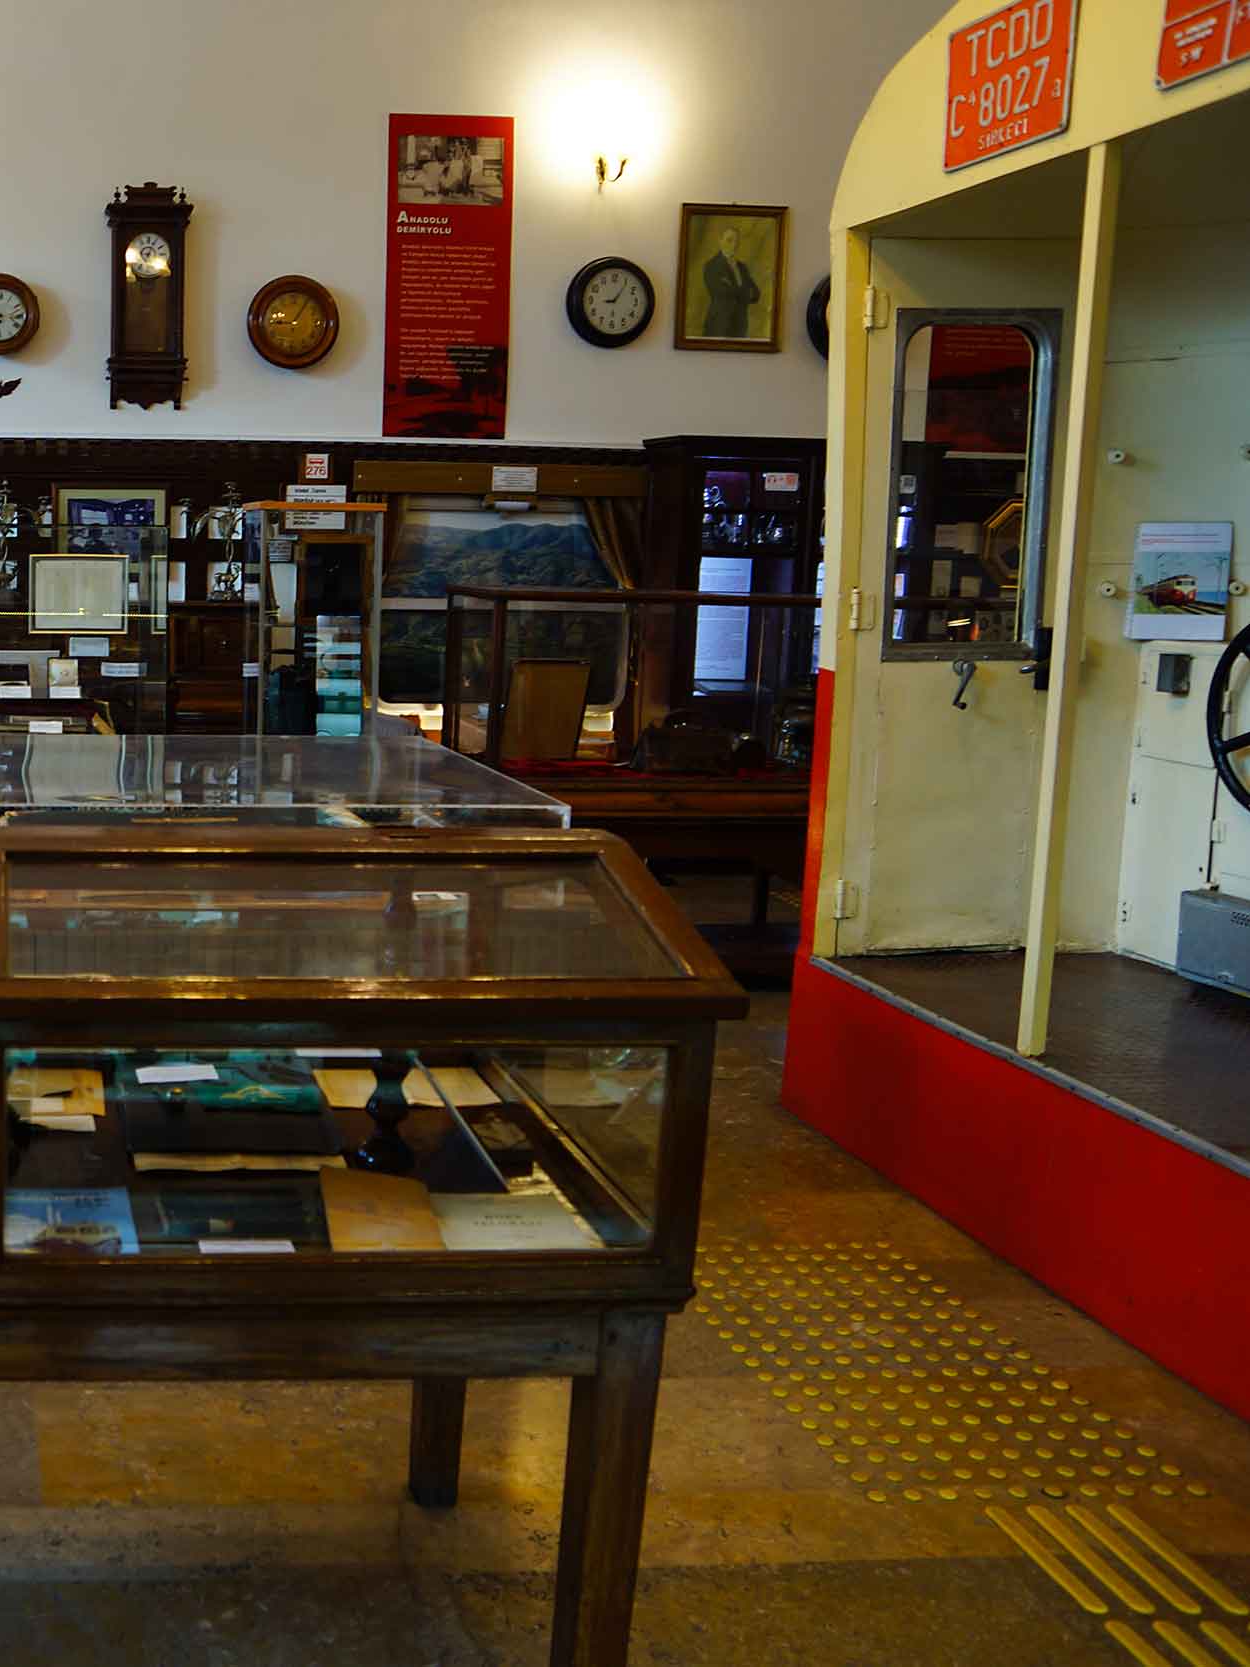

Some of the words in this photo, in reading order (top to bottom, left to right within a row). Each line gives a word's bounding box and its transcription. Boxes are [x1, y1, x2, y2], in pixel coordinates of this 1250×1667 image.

[966, 0, 1055, 77] TCDD
[396, 210, 449, 224] ANADOLU
[396, 225, 452, 234] DEMİRYOLU
[305, 465, 327, 476] 276
